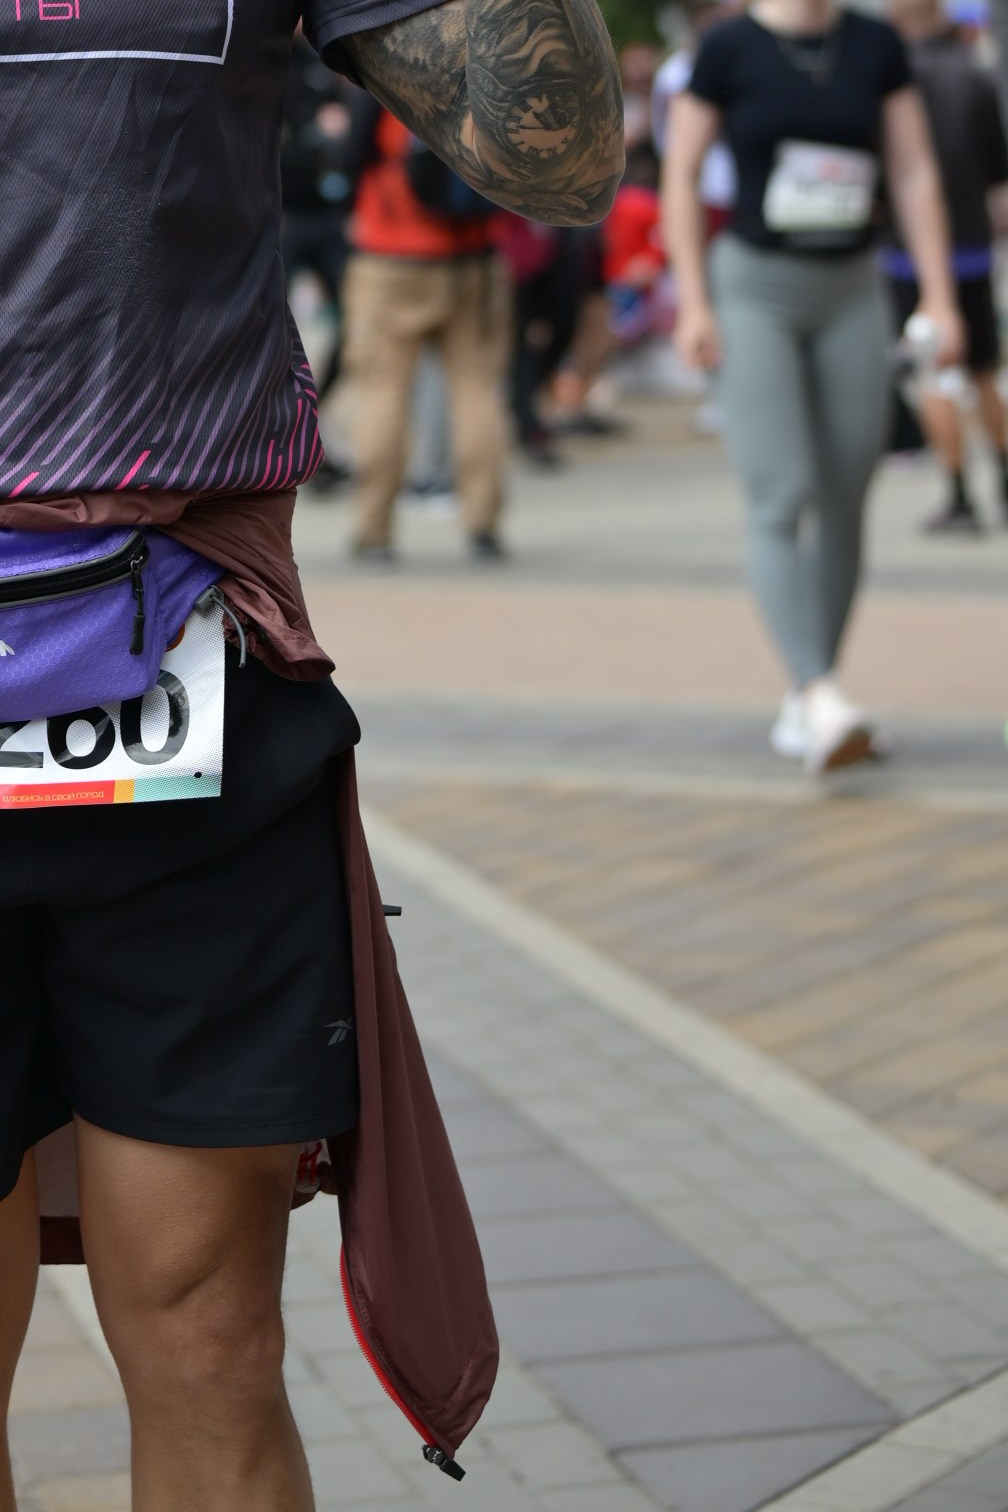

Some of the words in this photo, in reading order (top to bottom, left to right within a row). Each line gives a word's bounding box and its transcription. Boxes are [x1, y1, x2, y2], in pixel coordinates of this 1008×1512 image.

[2, 794, 44, 803] ВЛЮБИСЬ
[51, 792, 75, 801] СВОЙ
[76, 791, 105, 799] ГОРОД
